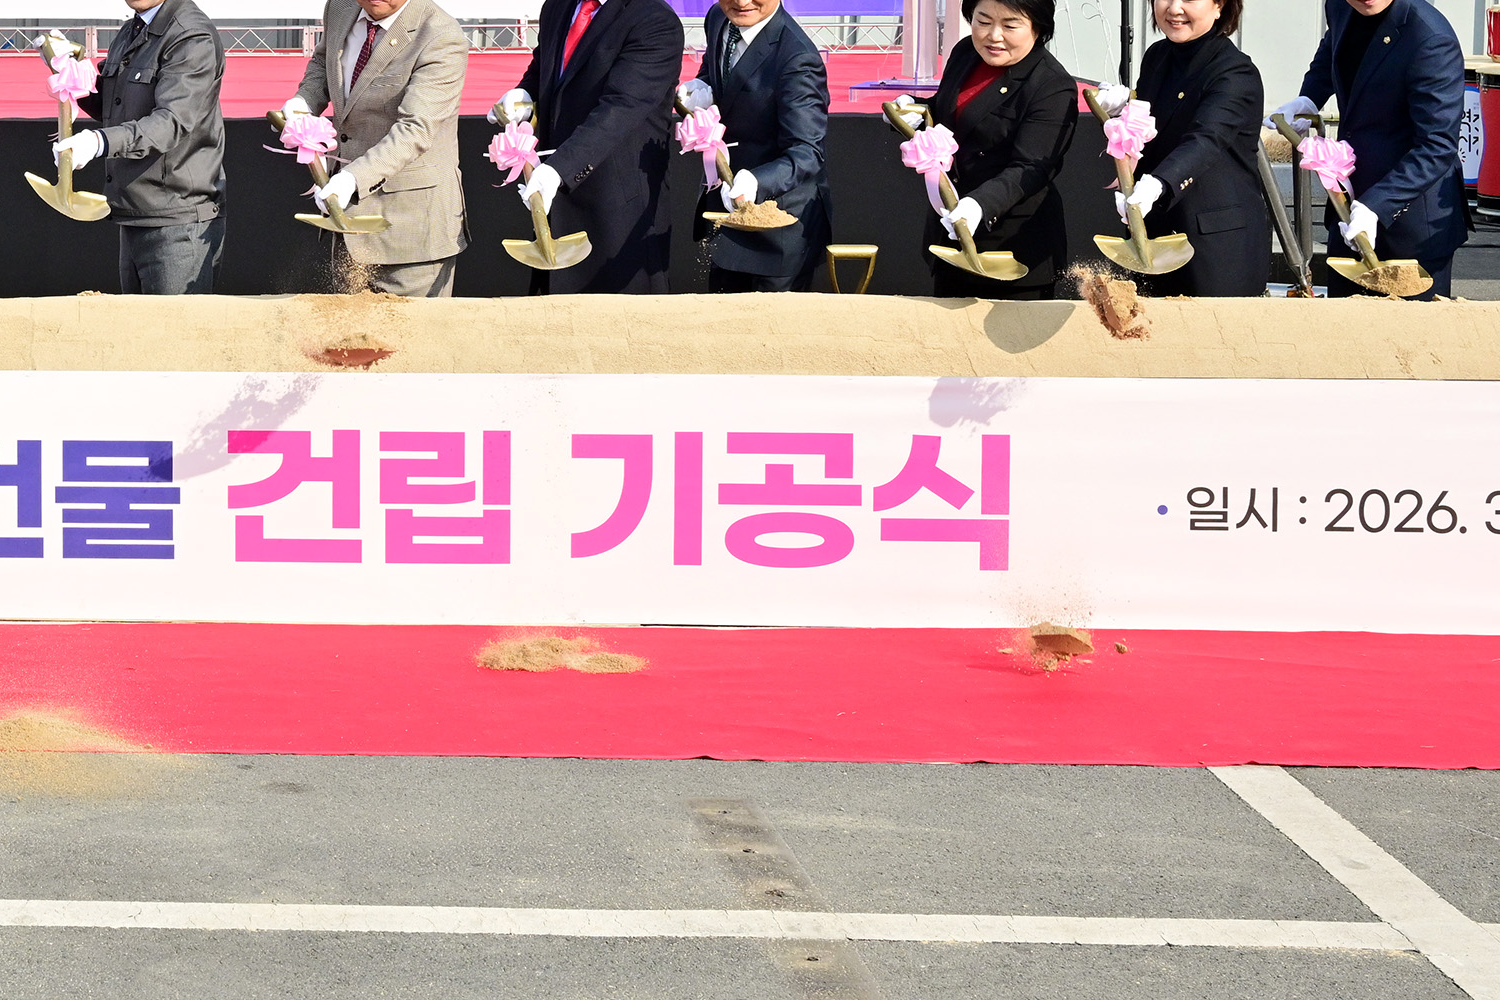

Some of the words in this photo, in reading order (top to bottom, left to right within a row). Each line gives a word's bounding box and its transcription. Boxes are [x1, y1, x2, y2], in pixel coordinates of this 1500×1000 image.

[228, 430, 512, 565] 건립
[571, 431, 1011, 571] 기공식
[1186, 486, 1279, 532] 일시
[1324, 488, 1468, 535] 2026.
